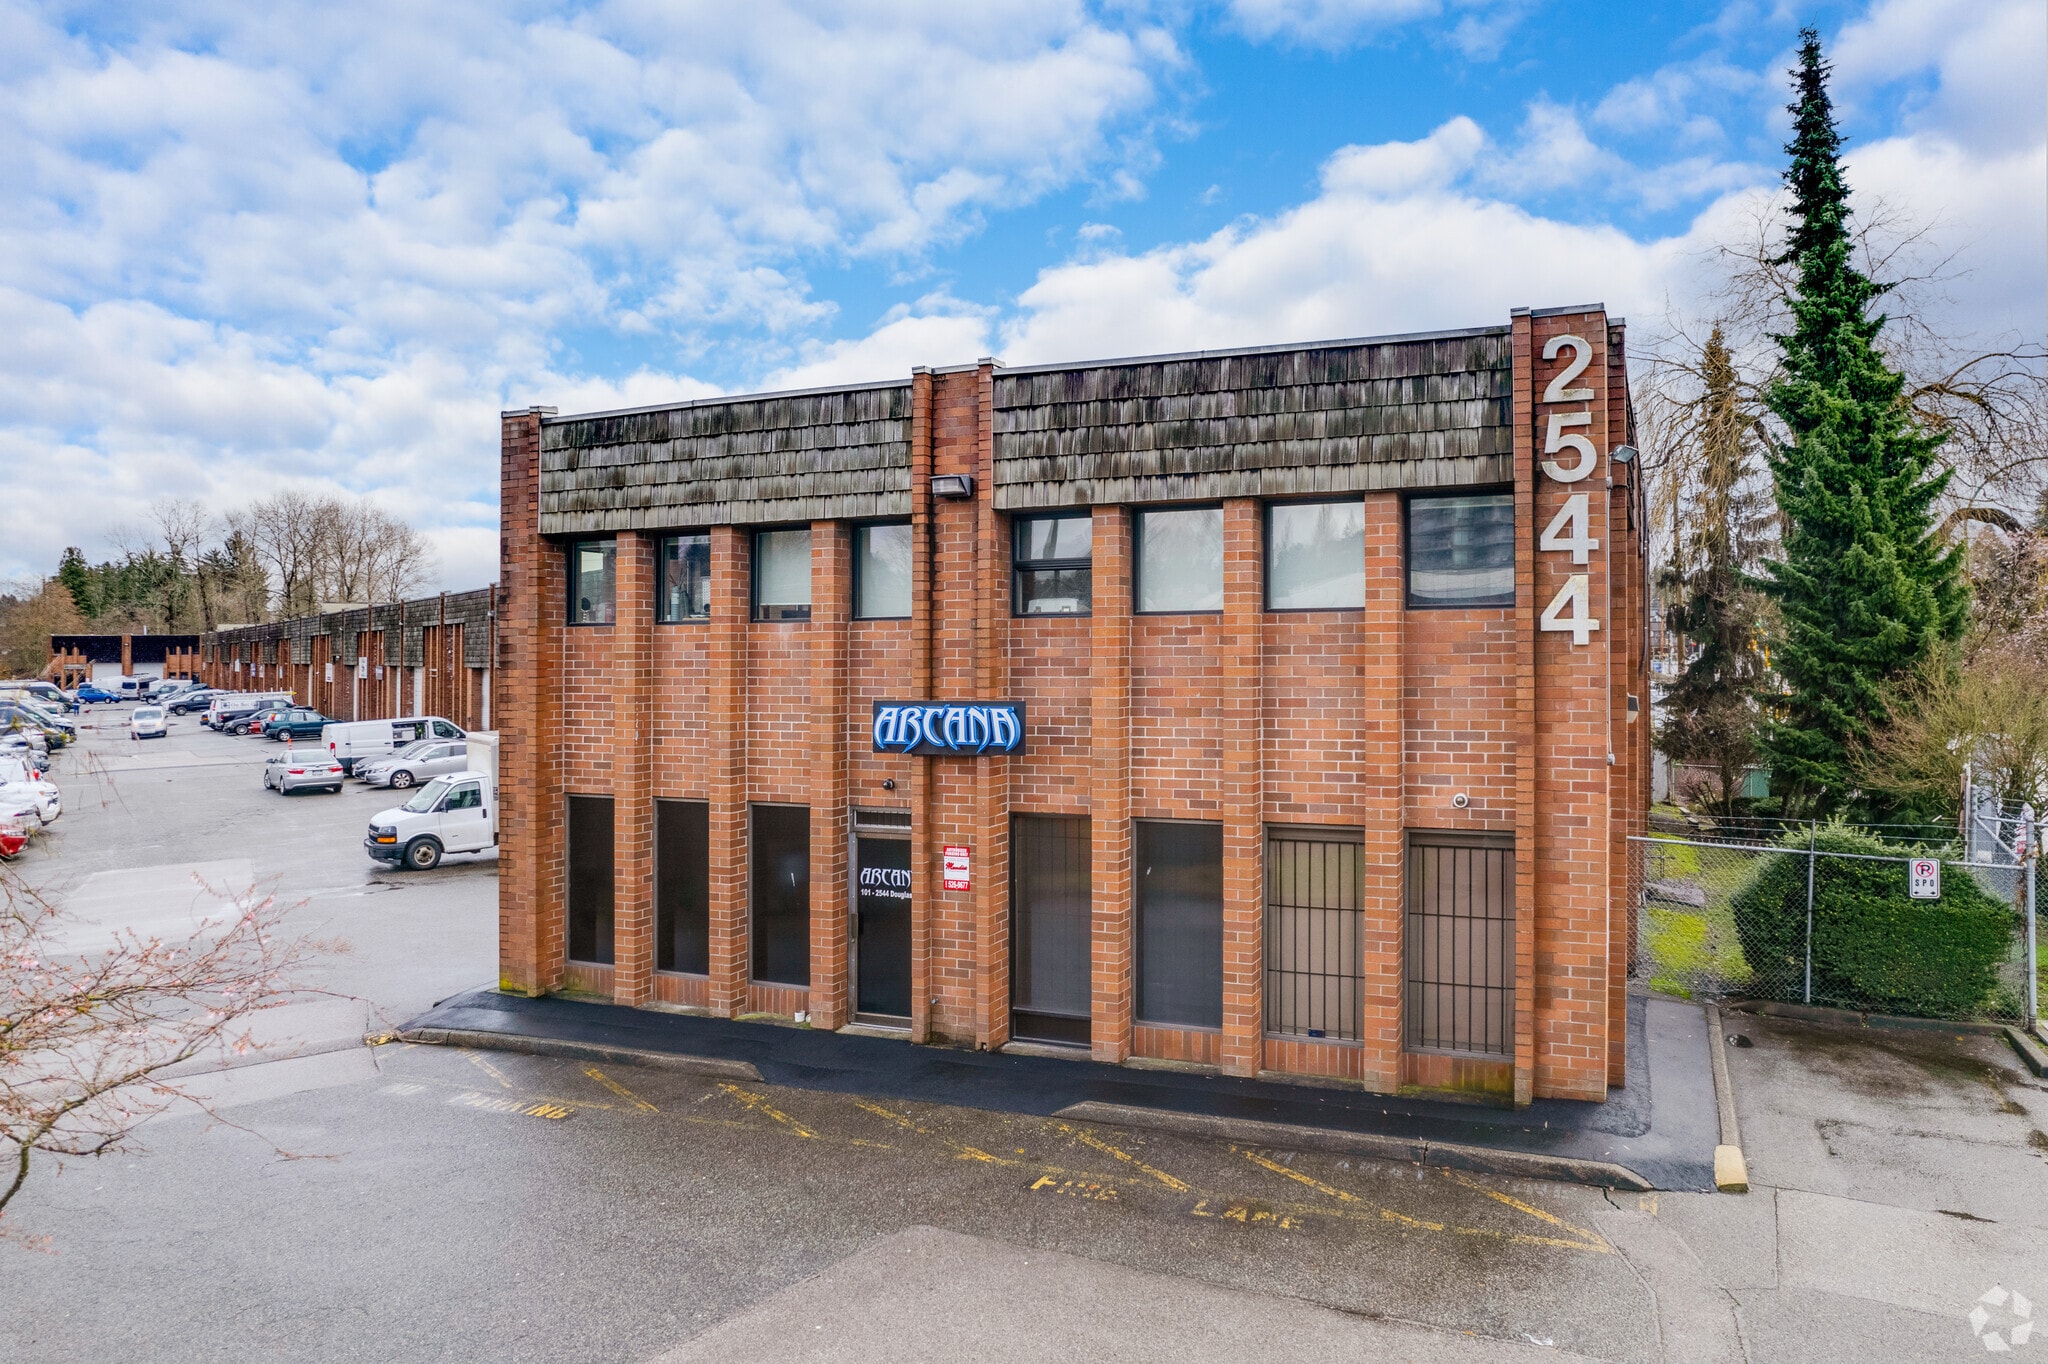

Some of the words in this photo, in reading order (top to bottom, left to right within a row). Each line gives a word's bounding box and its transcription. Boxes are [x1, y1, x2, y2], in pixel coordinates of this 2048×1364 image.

[1540, 334, 1600, 646] 2544
[874, 704, 1021, 753] ARCANA
[860, 867, 912, 889] ARCAN
[875, 889, 889, 897] 2544
